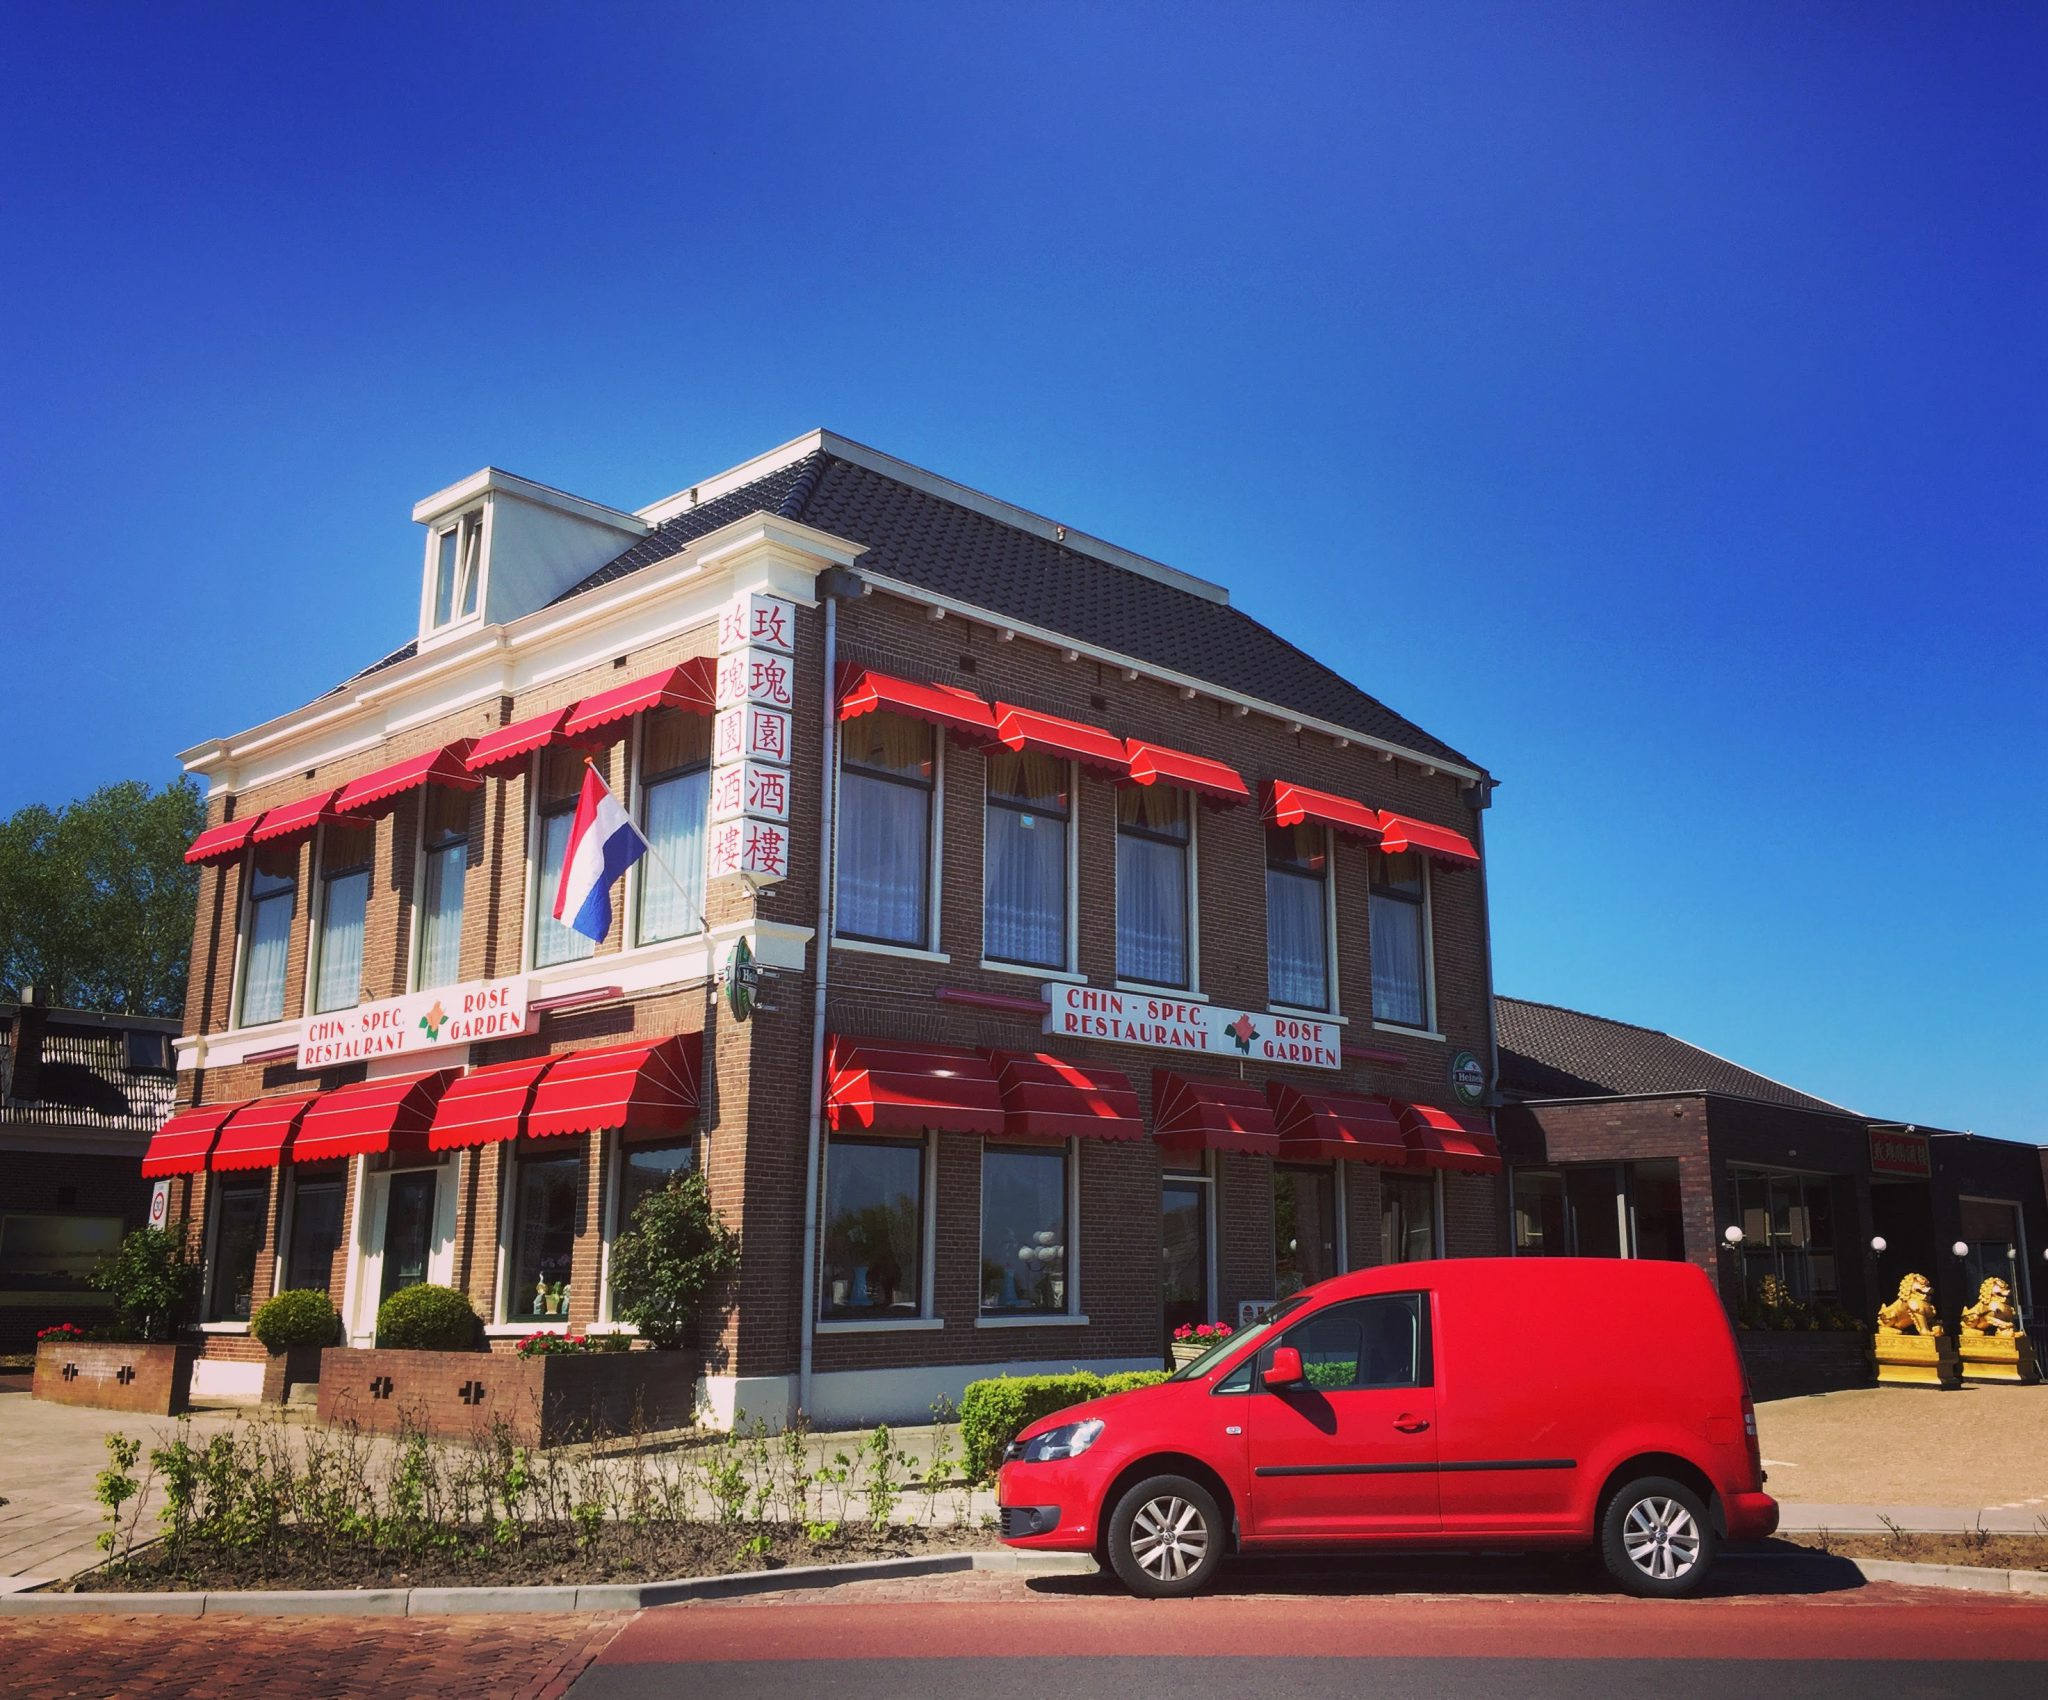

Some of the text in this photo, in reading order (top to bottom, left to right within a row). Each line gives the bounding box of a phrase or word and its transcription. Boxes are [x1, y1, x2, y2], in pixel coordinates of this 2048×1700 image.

[714, 603, 747, 874] 玫瑰園酒樓
[744, 605, 792, 875] 玫瑰園酒樓
[464, 986, 510, 1014] ROSE
[1066, 988, 1123, 1014] CHIN
[1148, 1000, 1208, 1027] SPEC.
[309, 1020, 345, 1042] CHIN
[450, 1011, 521, 1040] GARDEN
[1064, 1012, 1209, 1050] RESTAURANT
[1275, 1019, 1323, 1043] ROSE
[305, 1031, 406, 1065] RESTAURANT
[1263, 1039, 1337, 1067] GARDEN
